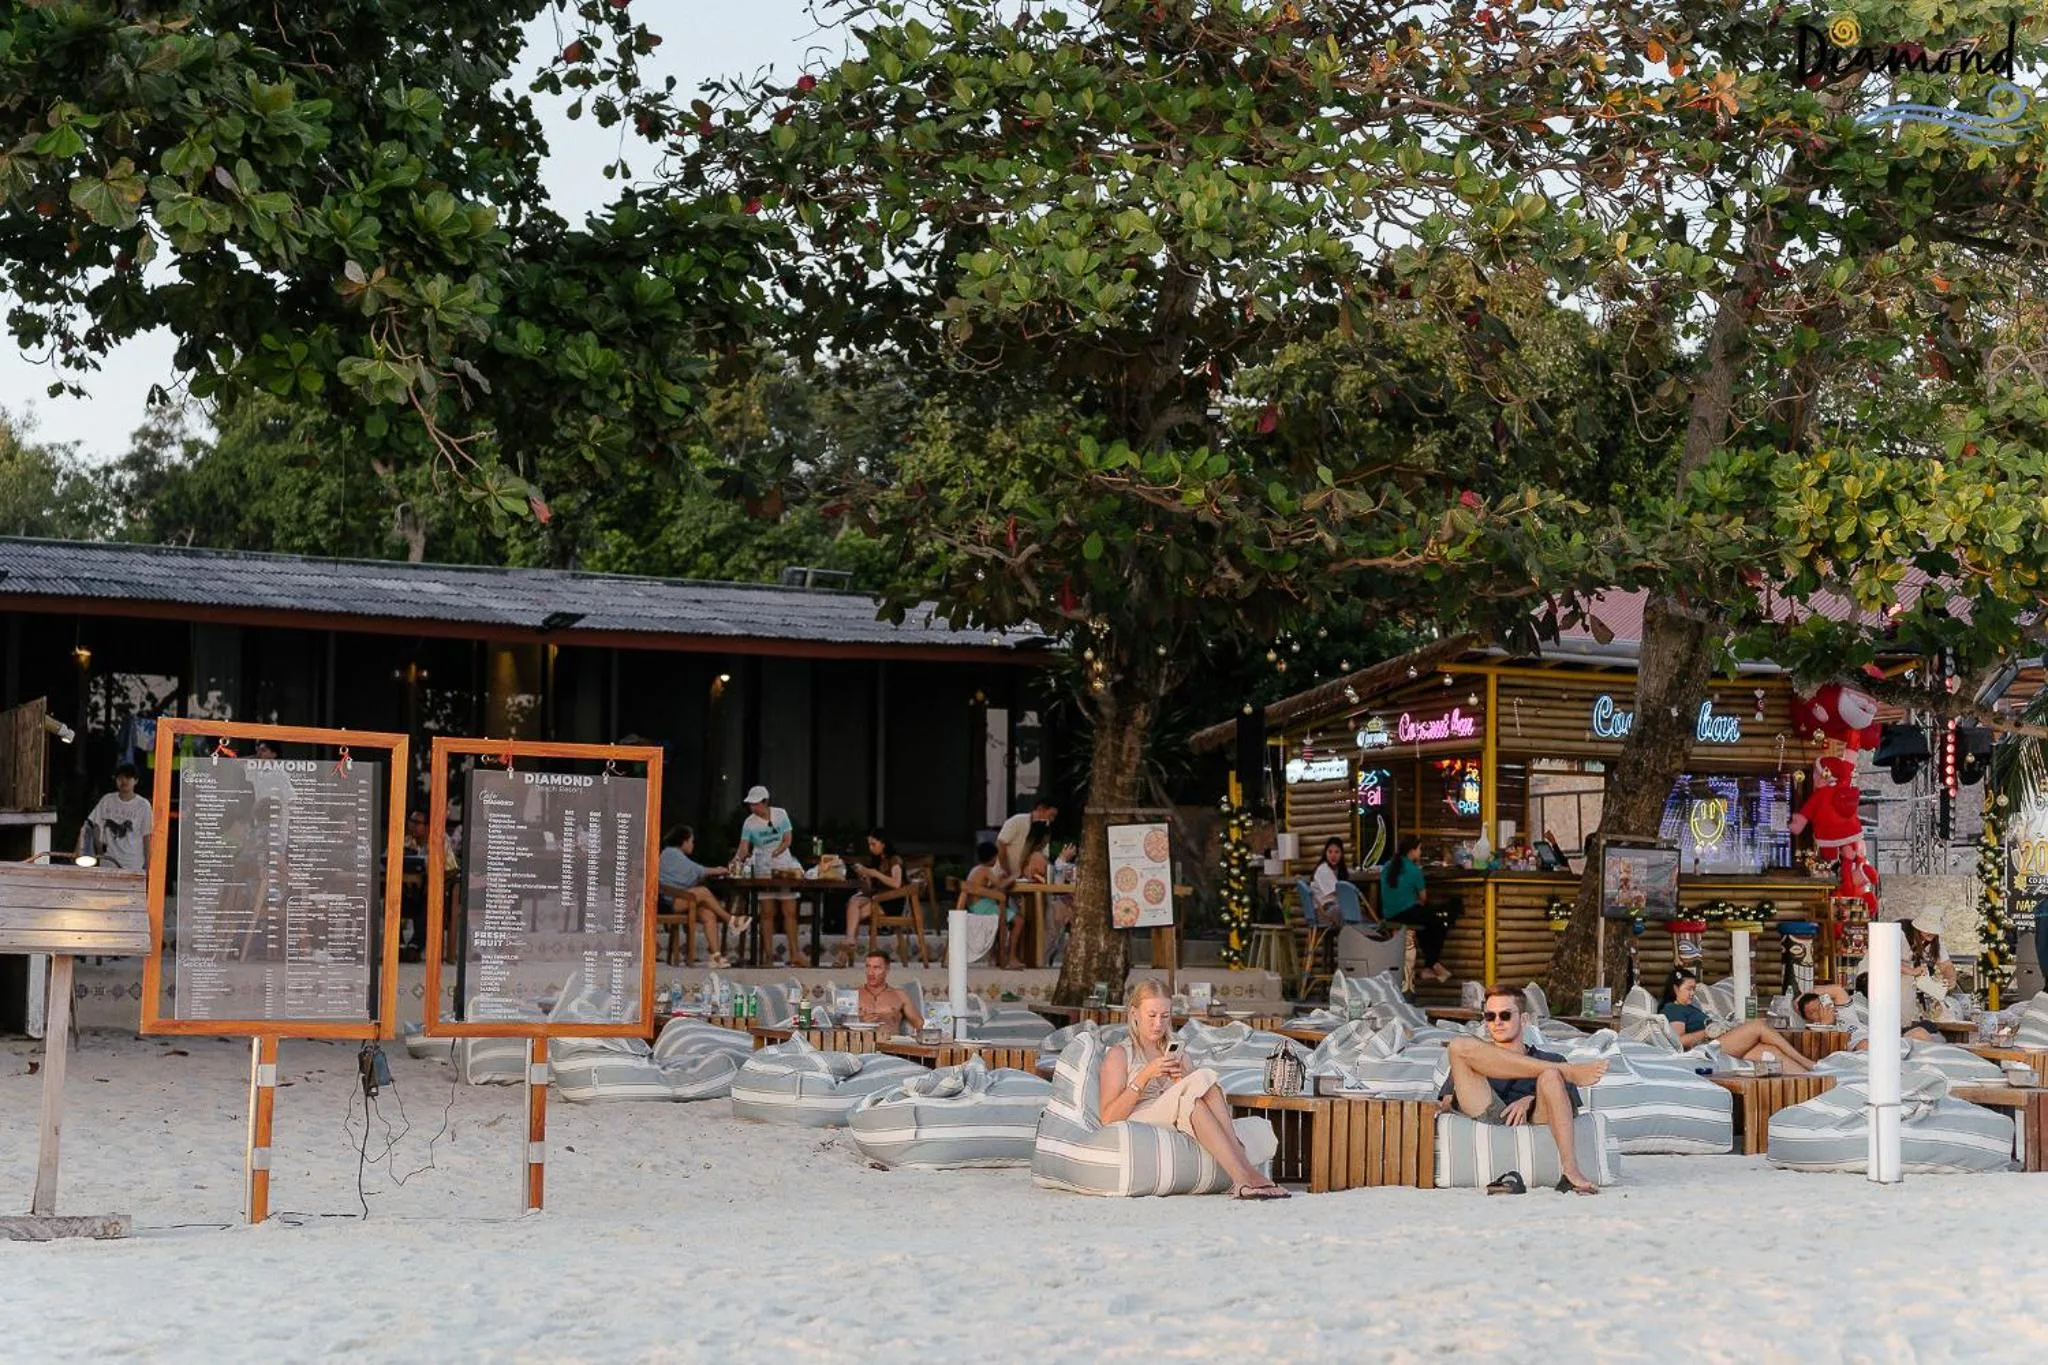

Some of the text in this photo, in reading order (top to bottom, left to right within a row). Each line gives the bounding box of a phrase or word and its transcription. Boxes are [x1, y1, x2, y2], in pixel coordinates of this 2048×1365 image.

[246, 760, 318, 773] DIAMOND
[524, 773, 593, 787] DIAMOND
[474, 931, 506, 939] FRESH
[473, 939, 503, 947] FRUIT
